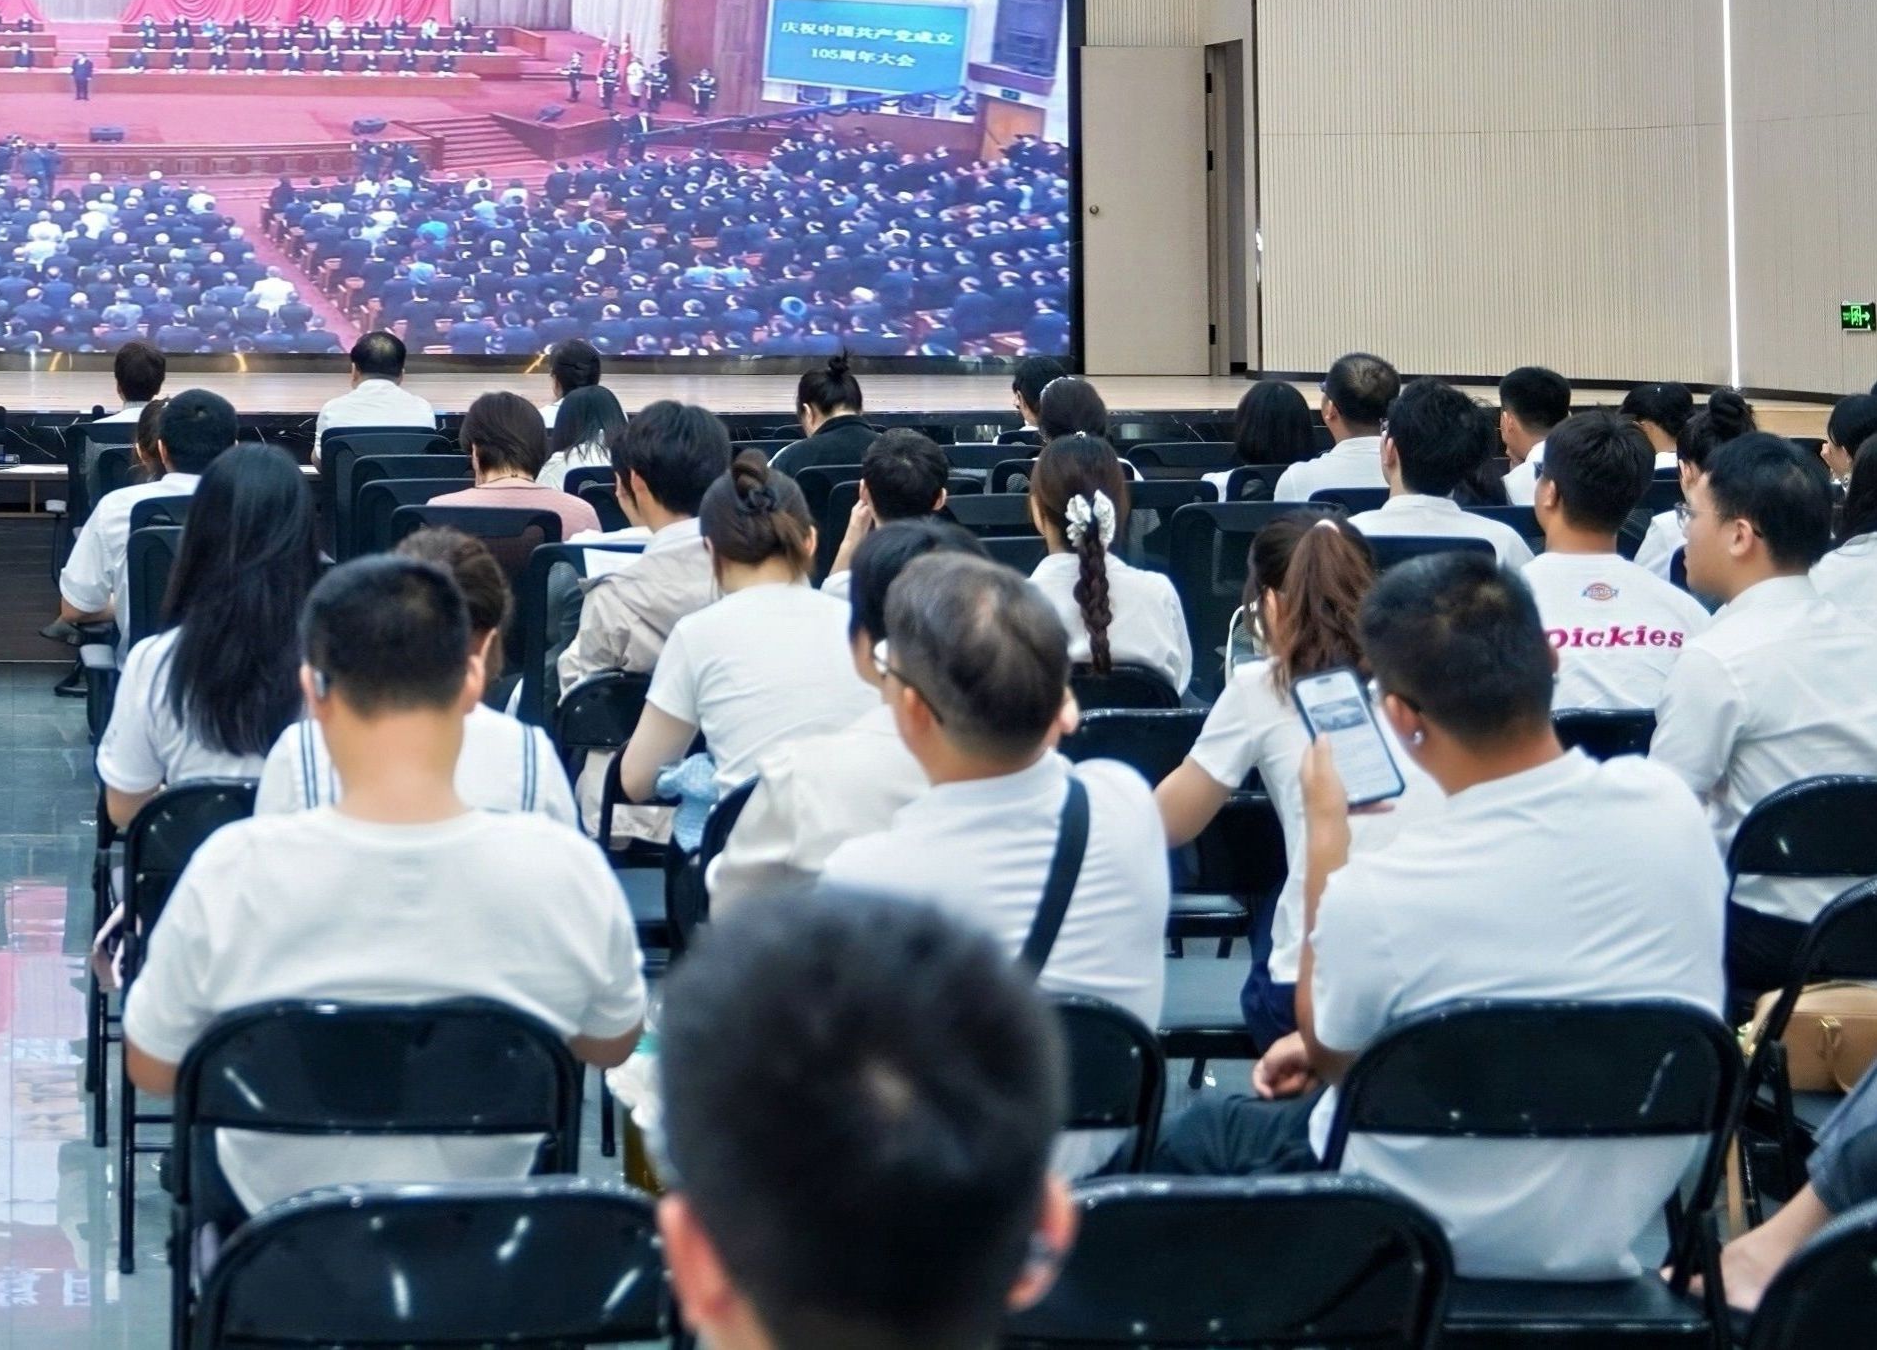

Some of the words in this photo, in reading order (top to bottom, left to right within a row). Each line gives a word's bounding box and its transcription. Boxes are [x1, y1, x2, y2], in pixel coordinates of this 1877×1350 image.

[781, 21, 954, 45] 庆祝中国共产党成立
[811, 48, 916, 67] 105周年大会
[1545, 625, 1684, 649] Dickies
